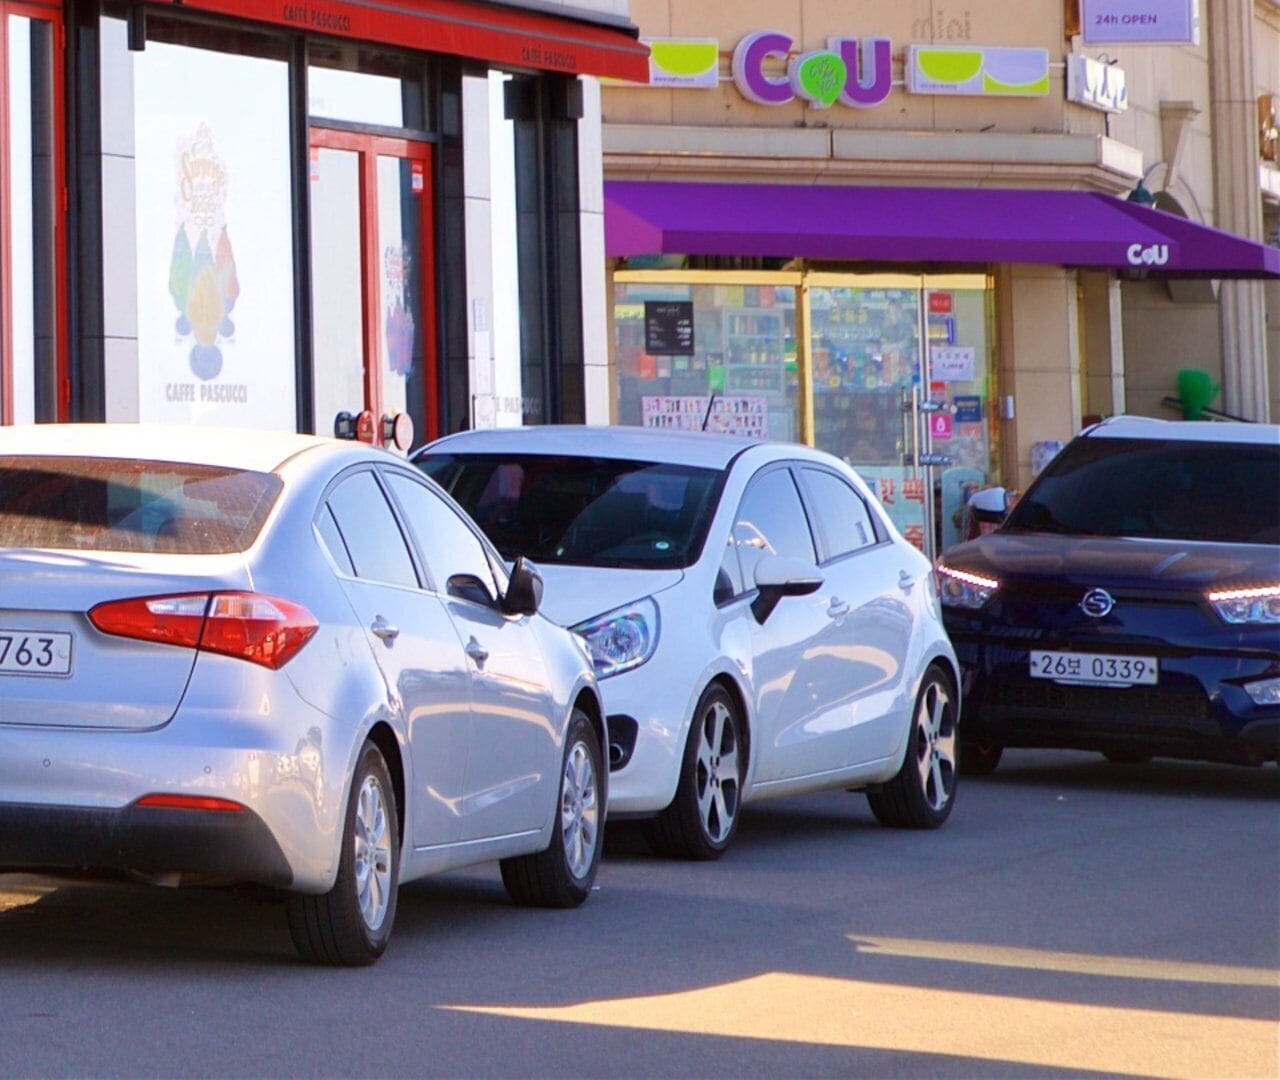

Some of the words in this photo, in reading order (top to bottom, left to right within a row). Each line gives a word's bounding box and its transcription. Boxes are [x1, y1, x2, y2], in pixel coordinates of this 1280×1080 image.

[310, 8, 352, 32] PASCUCCI
[1095, 14, 1119, 26] 24h
[1120, 14, 1158, 26] OPEN
[544, 50, 577, 71] PASCUCCI
[199, 383, 248, 405] PASCUCCI
[1041, 654, 1082, 676] 26보
[1091, 654, 1146, 680] 0339
